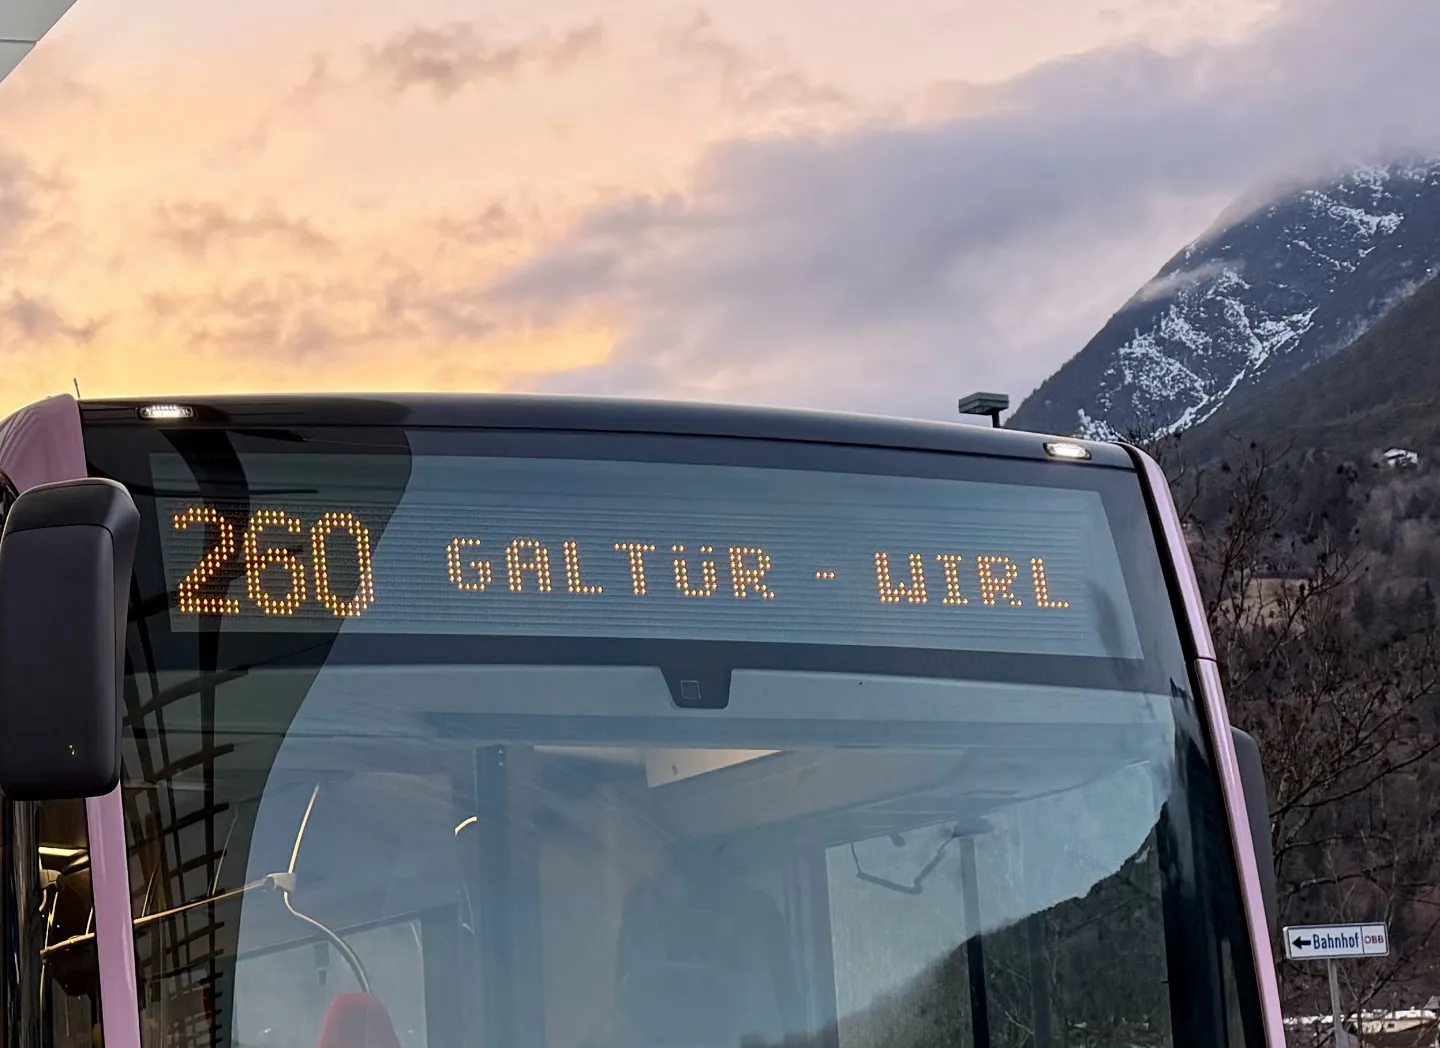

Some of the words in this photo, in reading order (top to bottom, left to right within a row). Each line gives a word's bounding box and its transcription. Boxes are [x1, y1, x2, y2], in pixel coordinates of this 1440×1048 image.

[173, 507, 375, 617] 260
[446, 536, 776, 599] GALTÜR
[874, 551, 1070, 608] WIRL
[1312, 932, 1360, 950] Bahnhof
